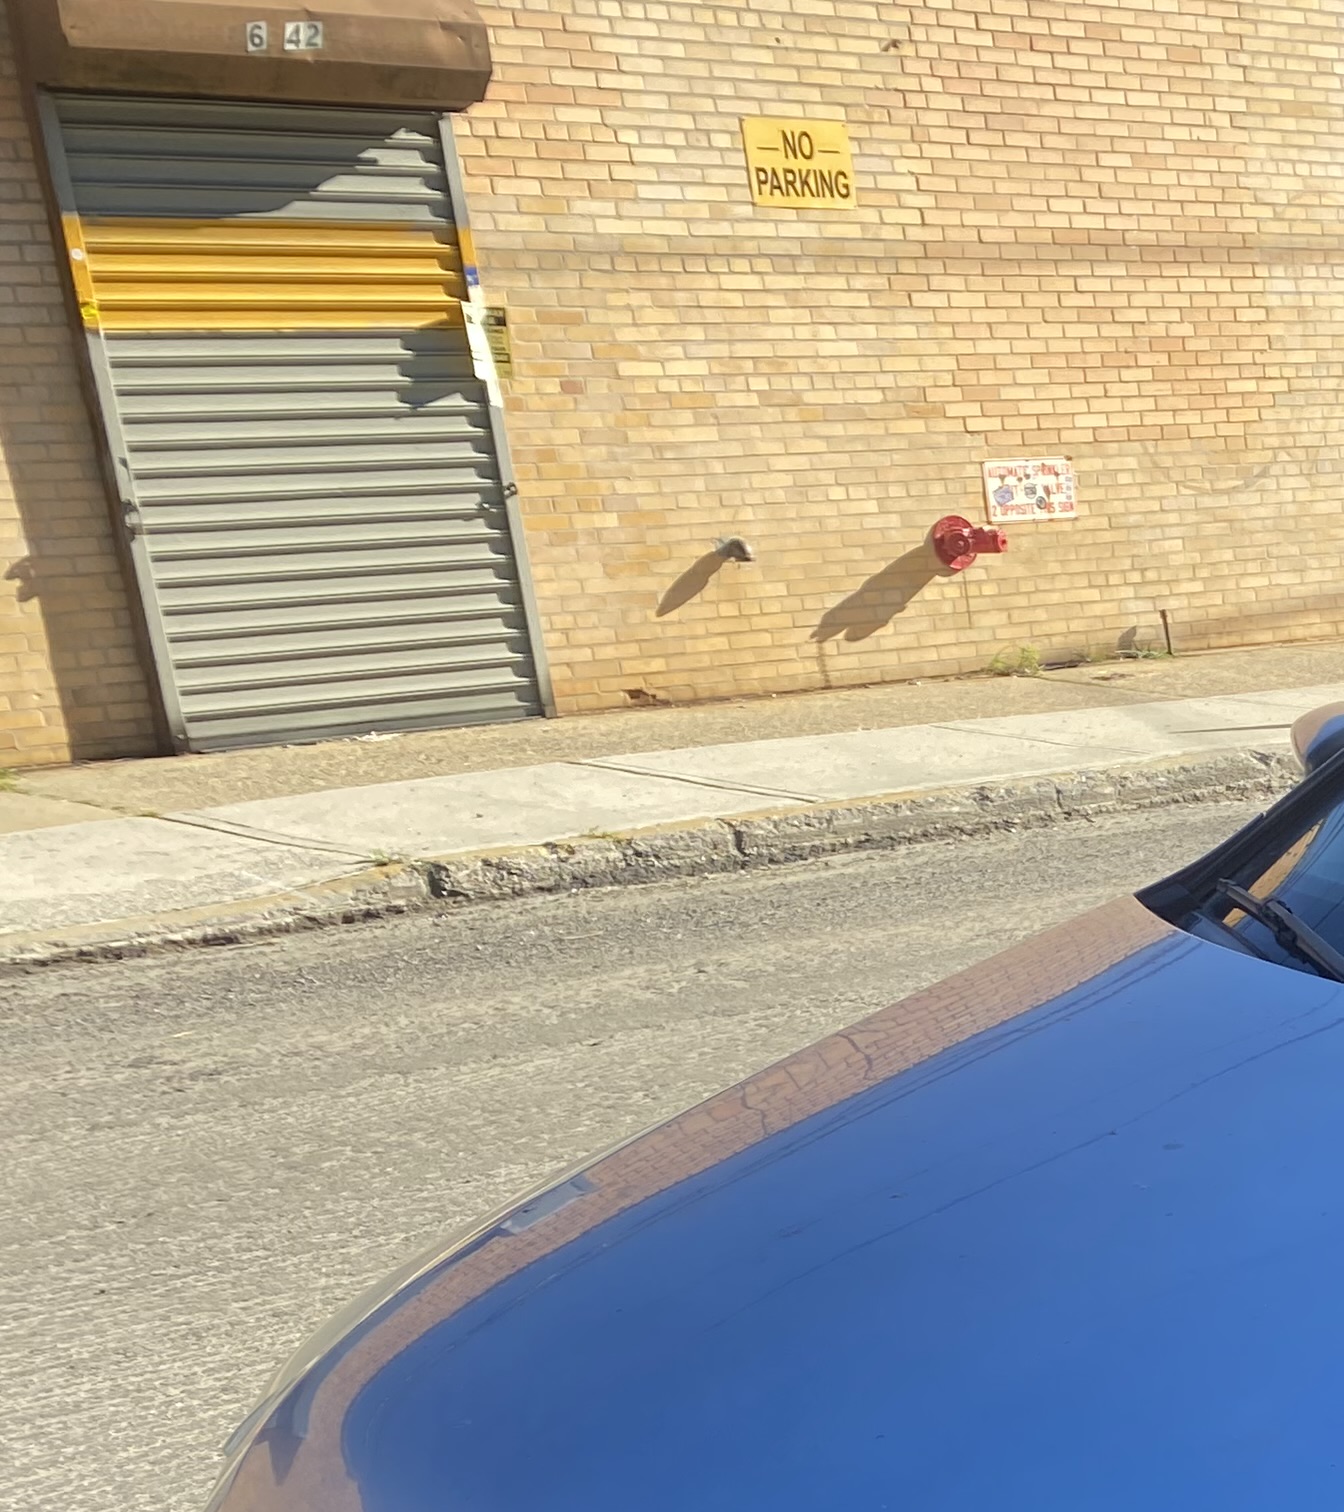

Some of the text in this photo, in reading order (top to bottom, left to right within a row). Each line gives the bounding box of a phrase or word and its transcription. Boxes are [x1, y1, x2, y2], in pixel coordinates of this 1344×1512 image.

[249, 23, 319, 48] 6 42
[781, 129, 814, 160] NO
[755, 166, 850, 199] PARKING
